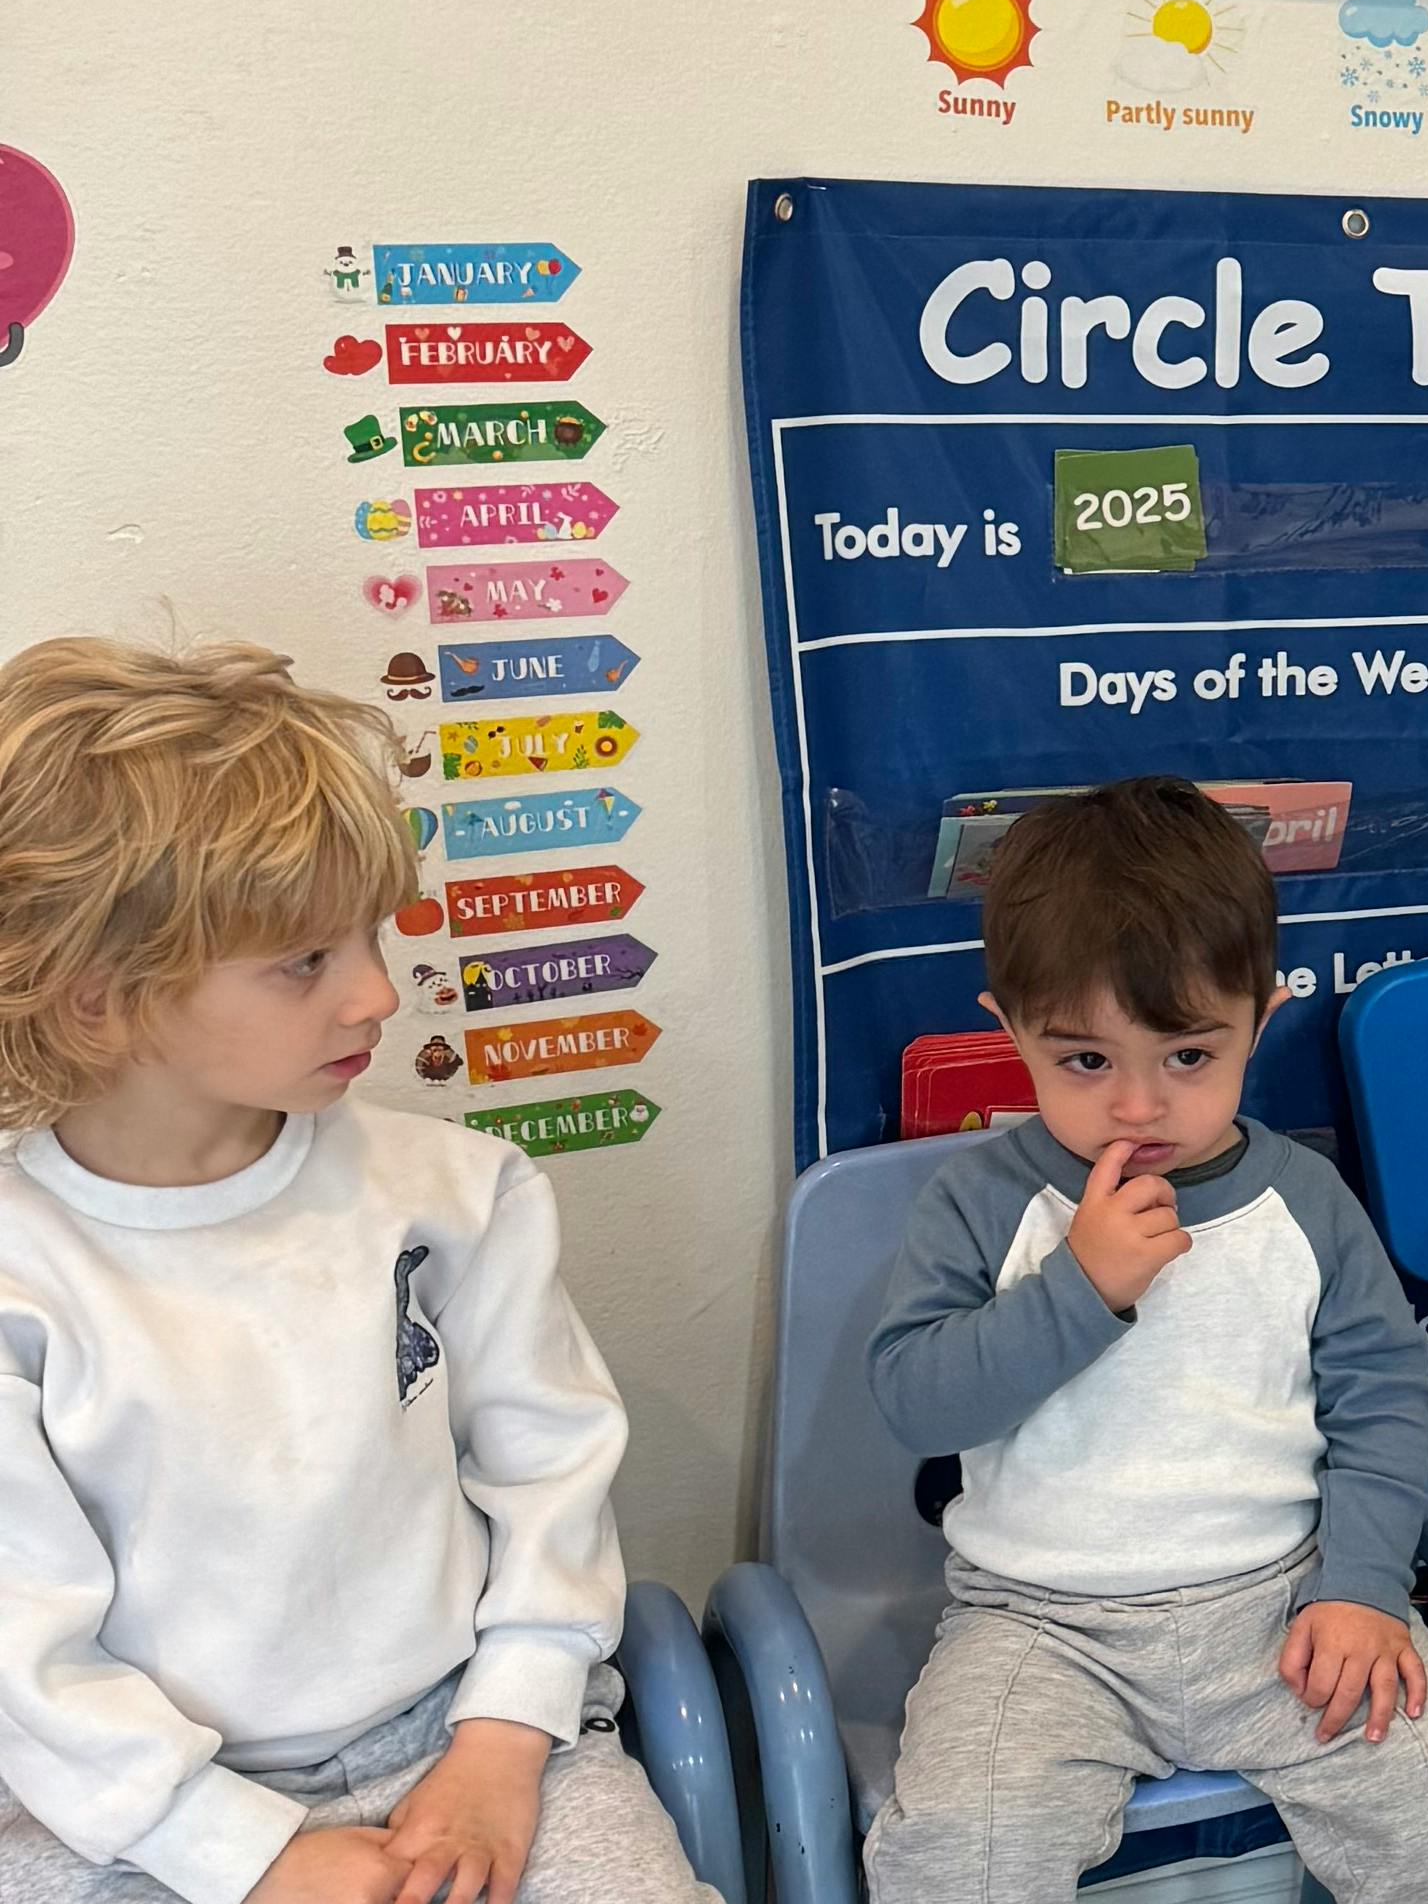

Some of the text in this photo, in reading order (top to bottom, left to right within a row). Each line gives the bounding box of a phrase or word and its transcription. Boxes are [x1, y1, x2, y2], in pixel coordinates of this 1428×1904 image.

[937, 90, 1017, 125] Sunny
[1105, 99, 1255, 133] Partly sunny
[1350, 105, 1424, 136] Snowy
[397, 261, 533, 287] JANUARY
[918, 256, 1330, 390] Circle
[399, 337, 552, 367] FEBRUARY
[436, 418, 547, 449] MARCH
[459, 502, 549, 528] APRIL
[1072, 482, 1193, 532] 2025
[814, 508, 1022, 569] Today is
[485, 578, 547, 604] MAY
[491, 654, 565, 682] JUNE
[1059, 662, 1178, 714] Days
[1193, 648, 1245, 700] of
[1257, 649, 1340, 698] the
[498, 732, 571, 759] JULY
[480, 806, 590, 839] AUGUST
[1263, 806, 1337, 846] pril
[456, 882, 623, 920] SEPTEMBER
[488, 954, 612, 992] OCTOBER
[483, 1028, 630, 1067] NOVEMBER
